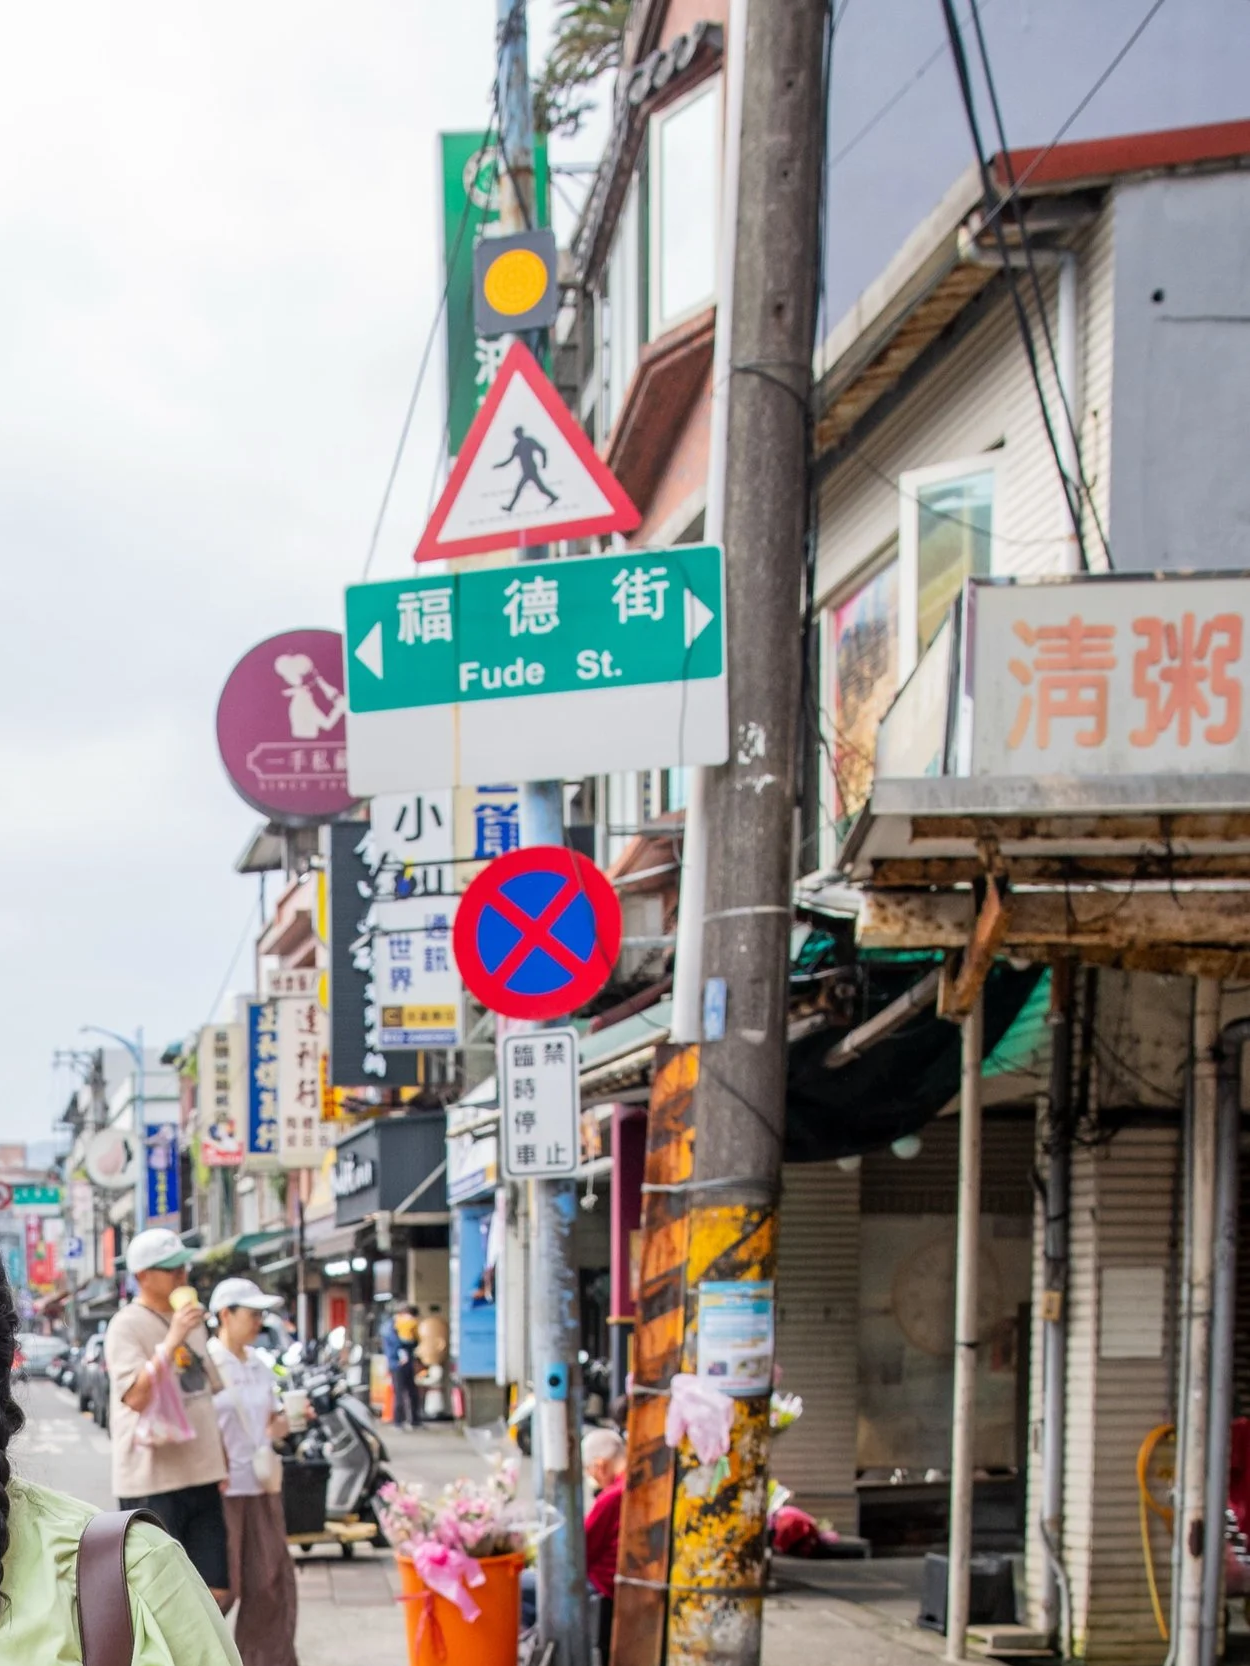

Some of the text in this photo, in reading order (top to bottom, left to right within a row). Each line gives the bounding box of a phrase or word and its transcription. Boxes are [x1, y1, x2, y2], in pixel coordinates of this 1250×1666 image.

[396, 566, 671, 646] 福德街
[458, 648, 623, 693] Fude St.
[1007, 610, 1244, 751] 清粥
[512, 1043, 538, 1166] 臨時停車
[543, 1041, 568, 1166] 禁止
